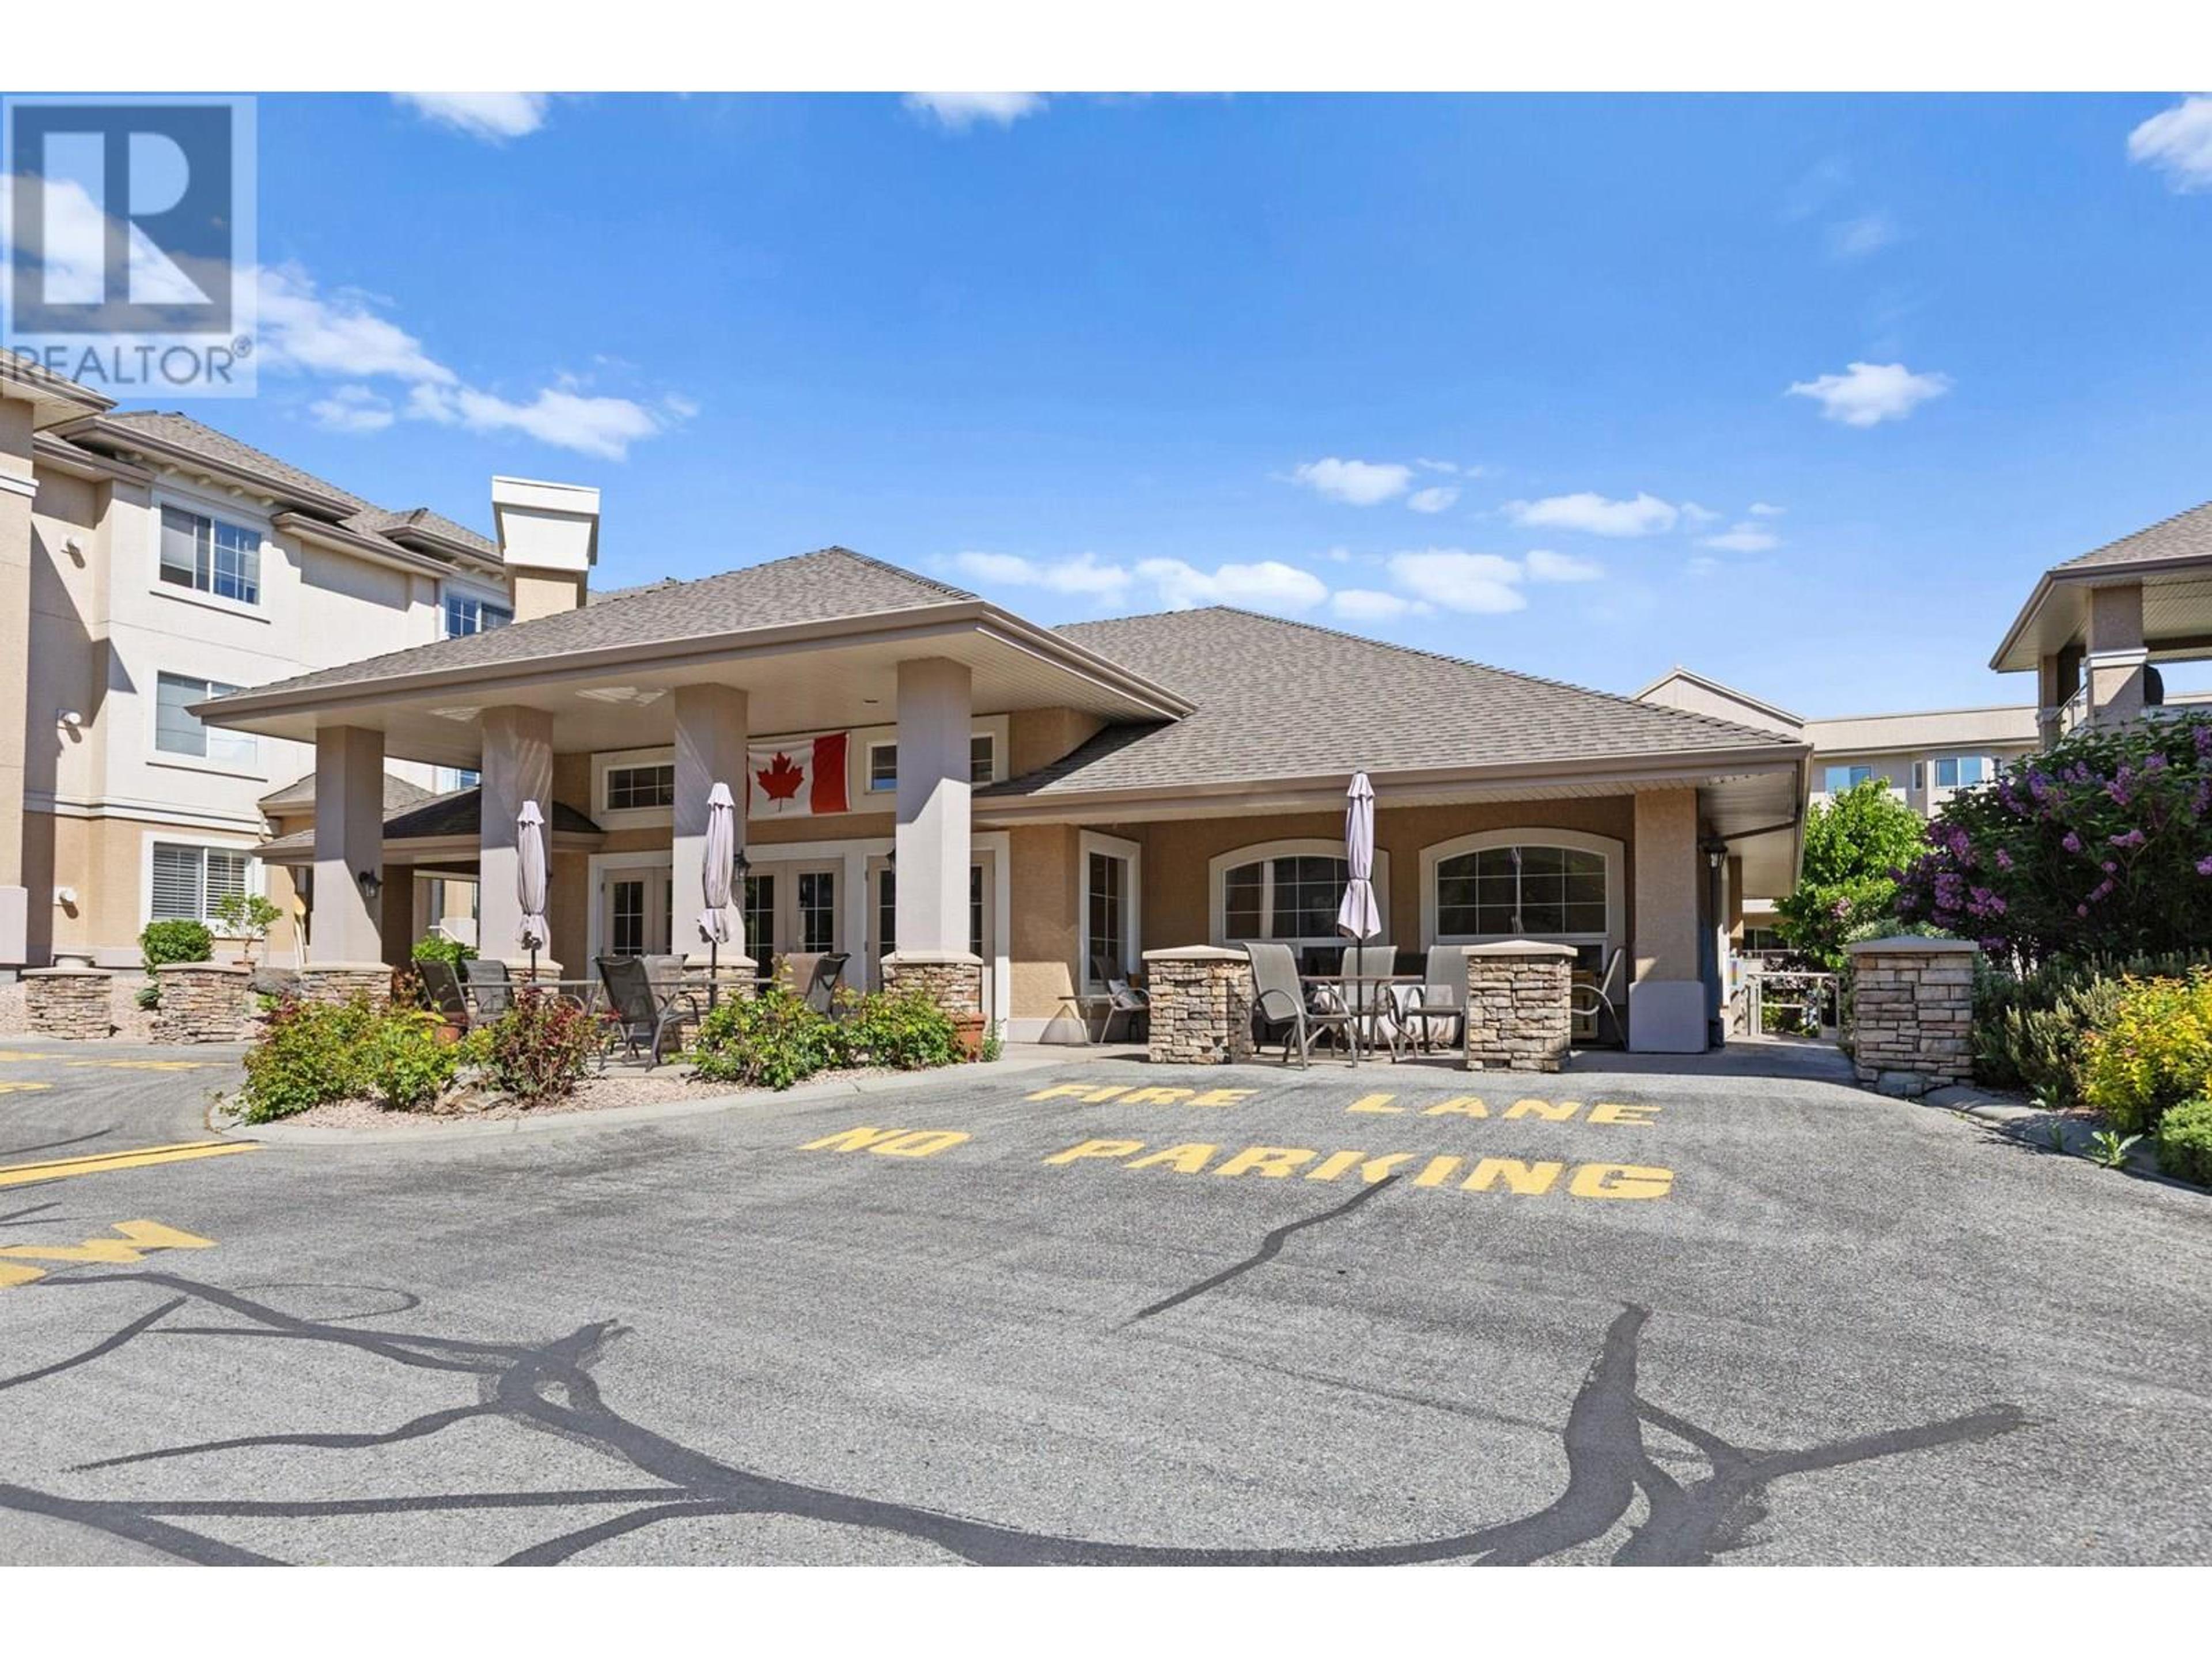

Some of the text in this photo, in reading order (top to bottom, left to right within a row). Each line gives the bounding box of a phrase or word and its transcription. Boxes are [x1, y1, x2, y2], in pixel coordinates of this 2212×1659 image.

[1024, 1084, 1662, 1126] FIRE LANE
[798, 1127, 1675, 1200] NO PARKING
